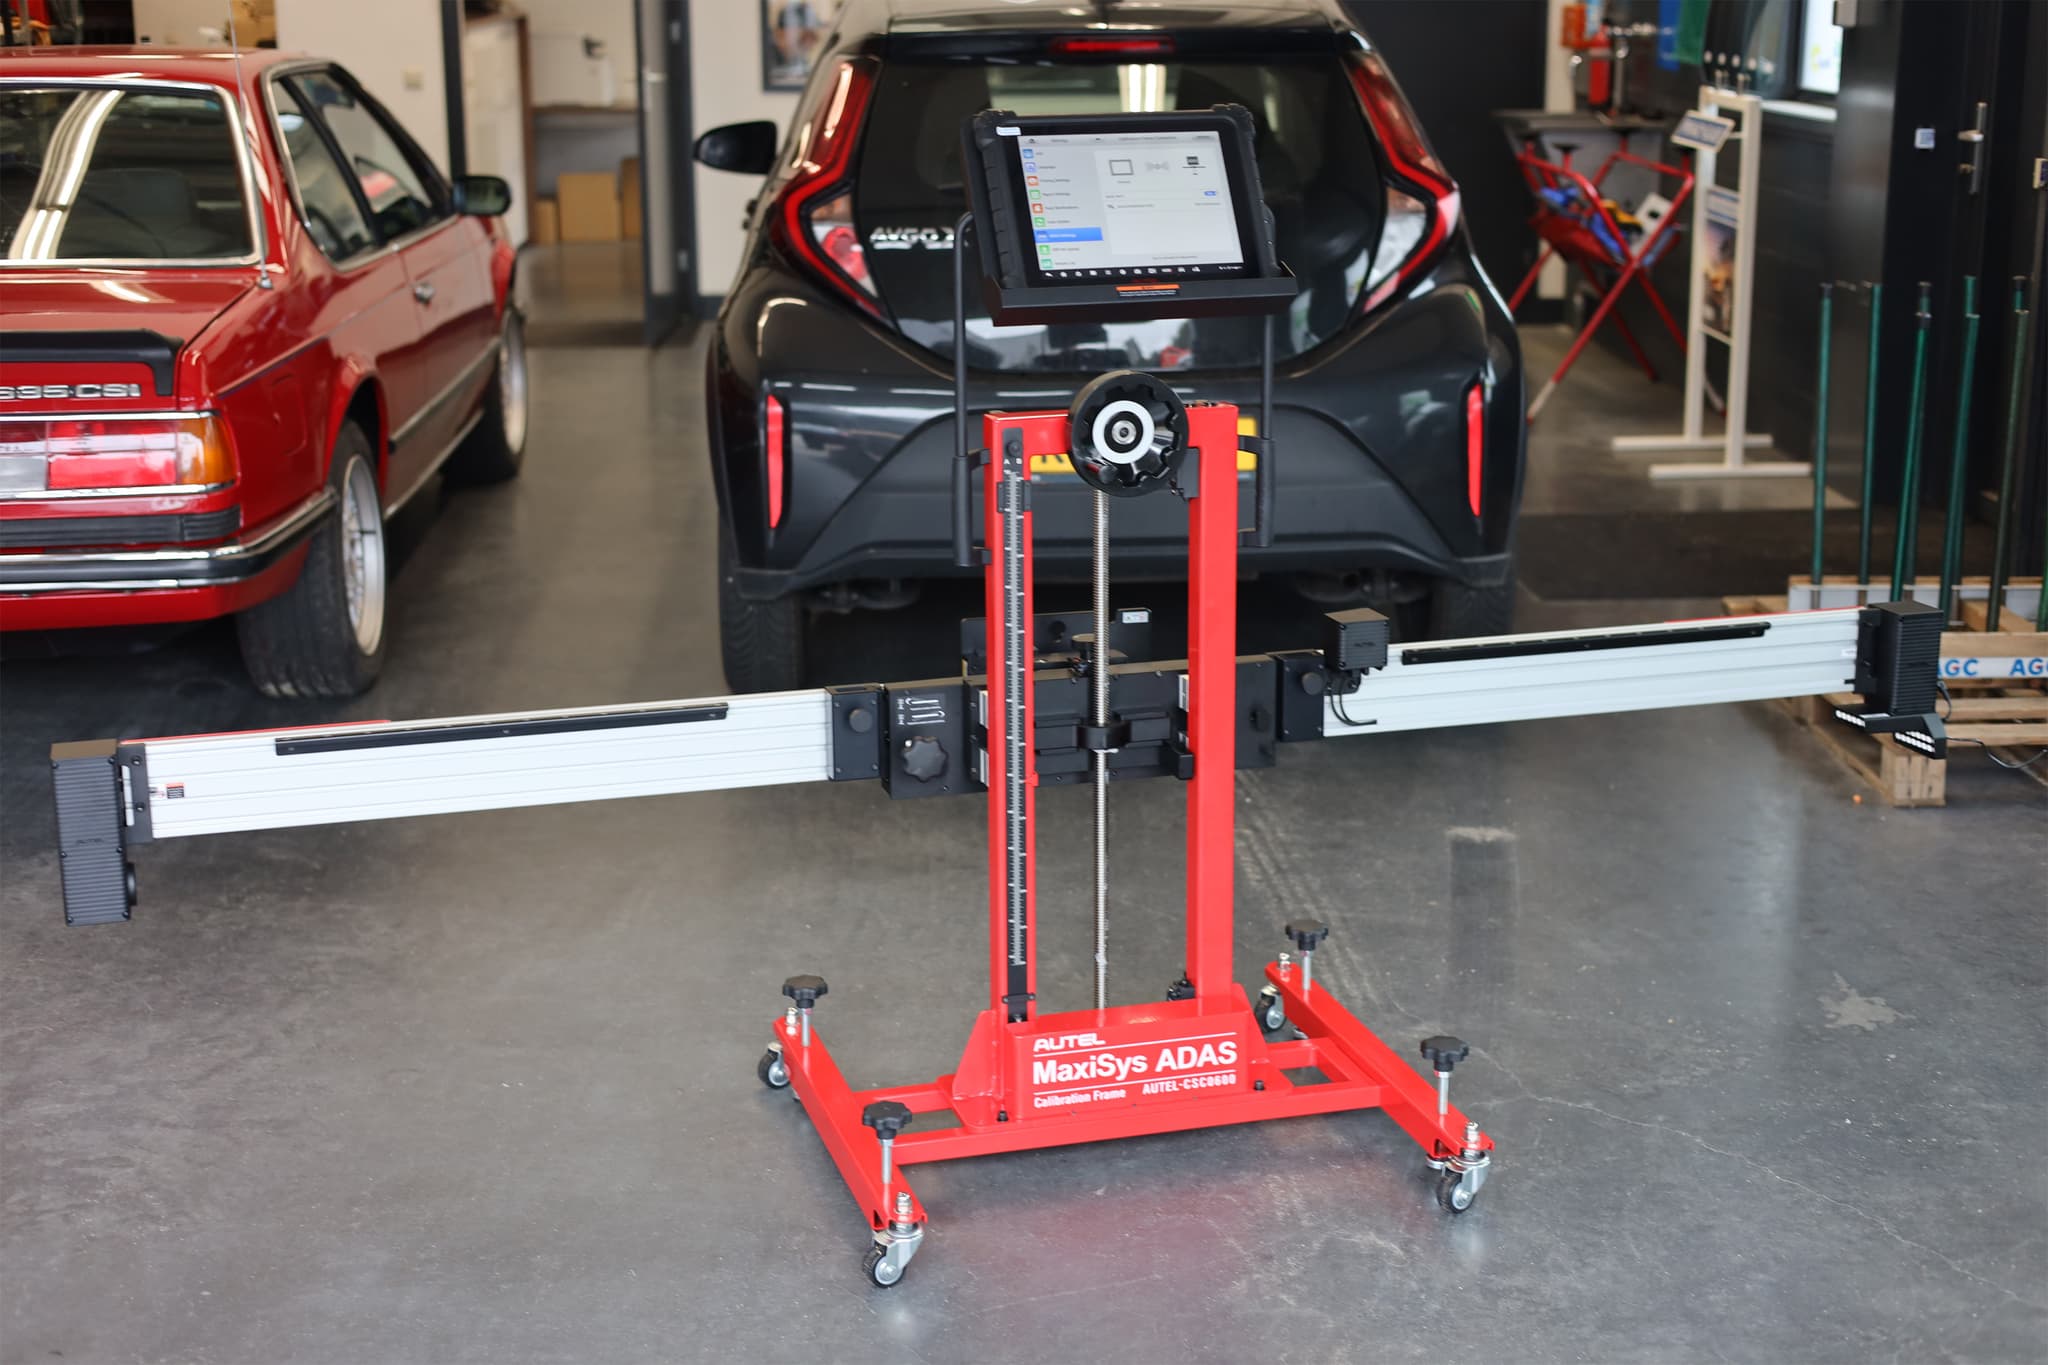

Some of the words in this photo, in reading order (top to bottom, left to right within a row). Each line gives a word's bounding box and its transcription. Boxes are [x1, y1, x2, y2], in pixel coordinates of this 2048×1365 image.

[2008, 657, 2048, 677] AG
[1033, 1032, 1106, 1052] AUTEL
[1033, 1053, 1148, 1085] MaxiSys
[1155, 1041, 1238, 1072] ADAS
[1033, 1092, 1092, 1108] Calibration
[1093, 1089, 1126, 1101] Frame
